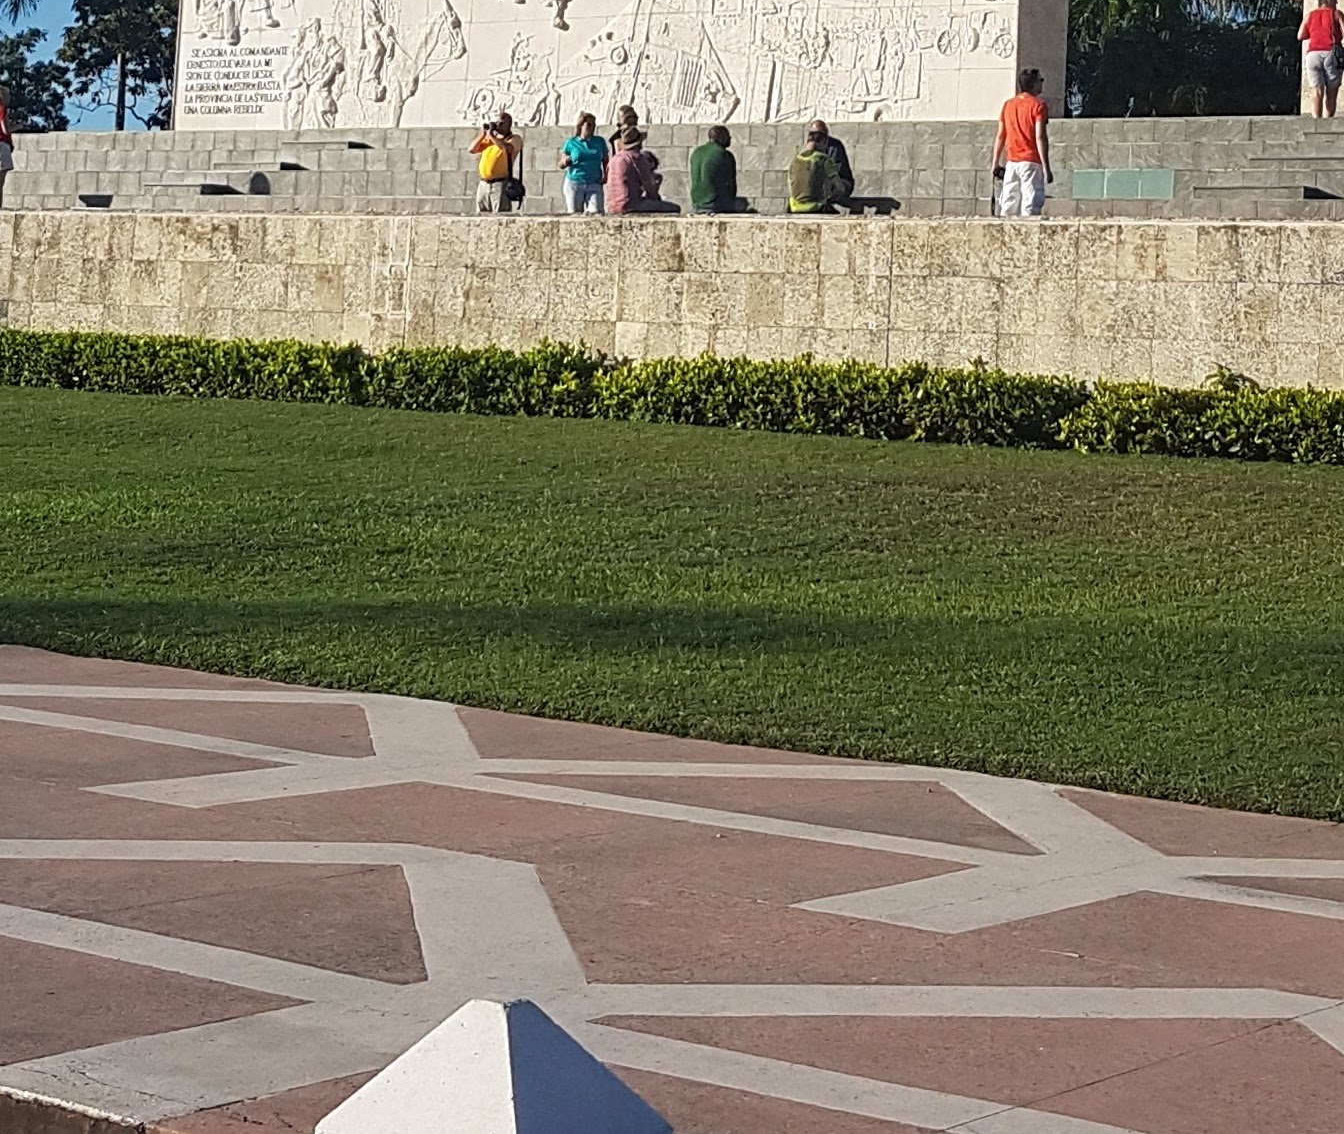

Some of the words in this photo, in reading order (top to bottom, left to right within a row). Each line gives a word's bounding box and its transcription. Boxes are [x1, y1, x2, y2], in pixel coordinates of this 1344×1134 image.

[229, 47, 238, 57] AL
[240, 46, 289, 56] COMANDANTE
[253, 59, 262, 68] LA
[203, 71, 212, 80] DE
[252, 70, 275, 79] DESDE
[185, 83, 194, 92] LA
[184, 94, 193, 103] LA
[195, 94, 233, 103] PROVINCIA
[235, 93, 243, 102] DE
[245, 93, 257, 102] LAS
[200, 105, 232, 114] COLUMNA
[233, 105, 265, 114] REBELDE
